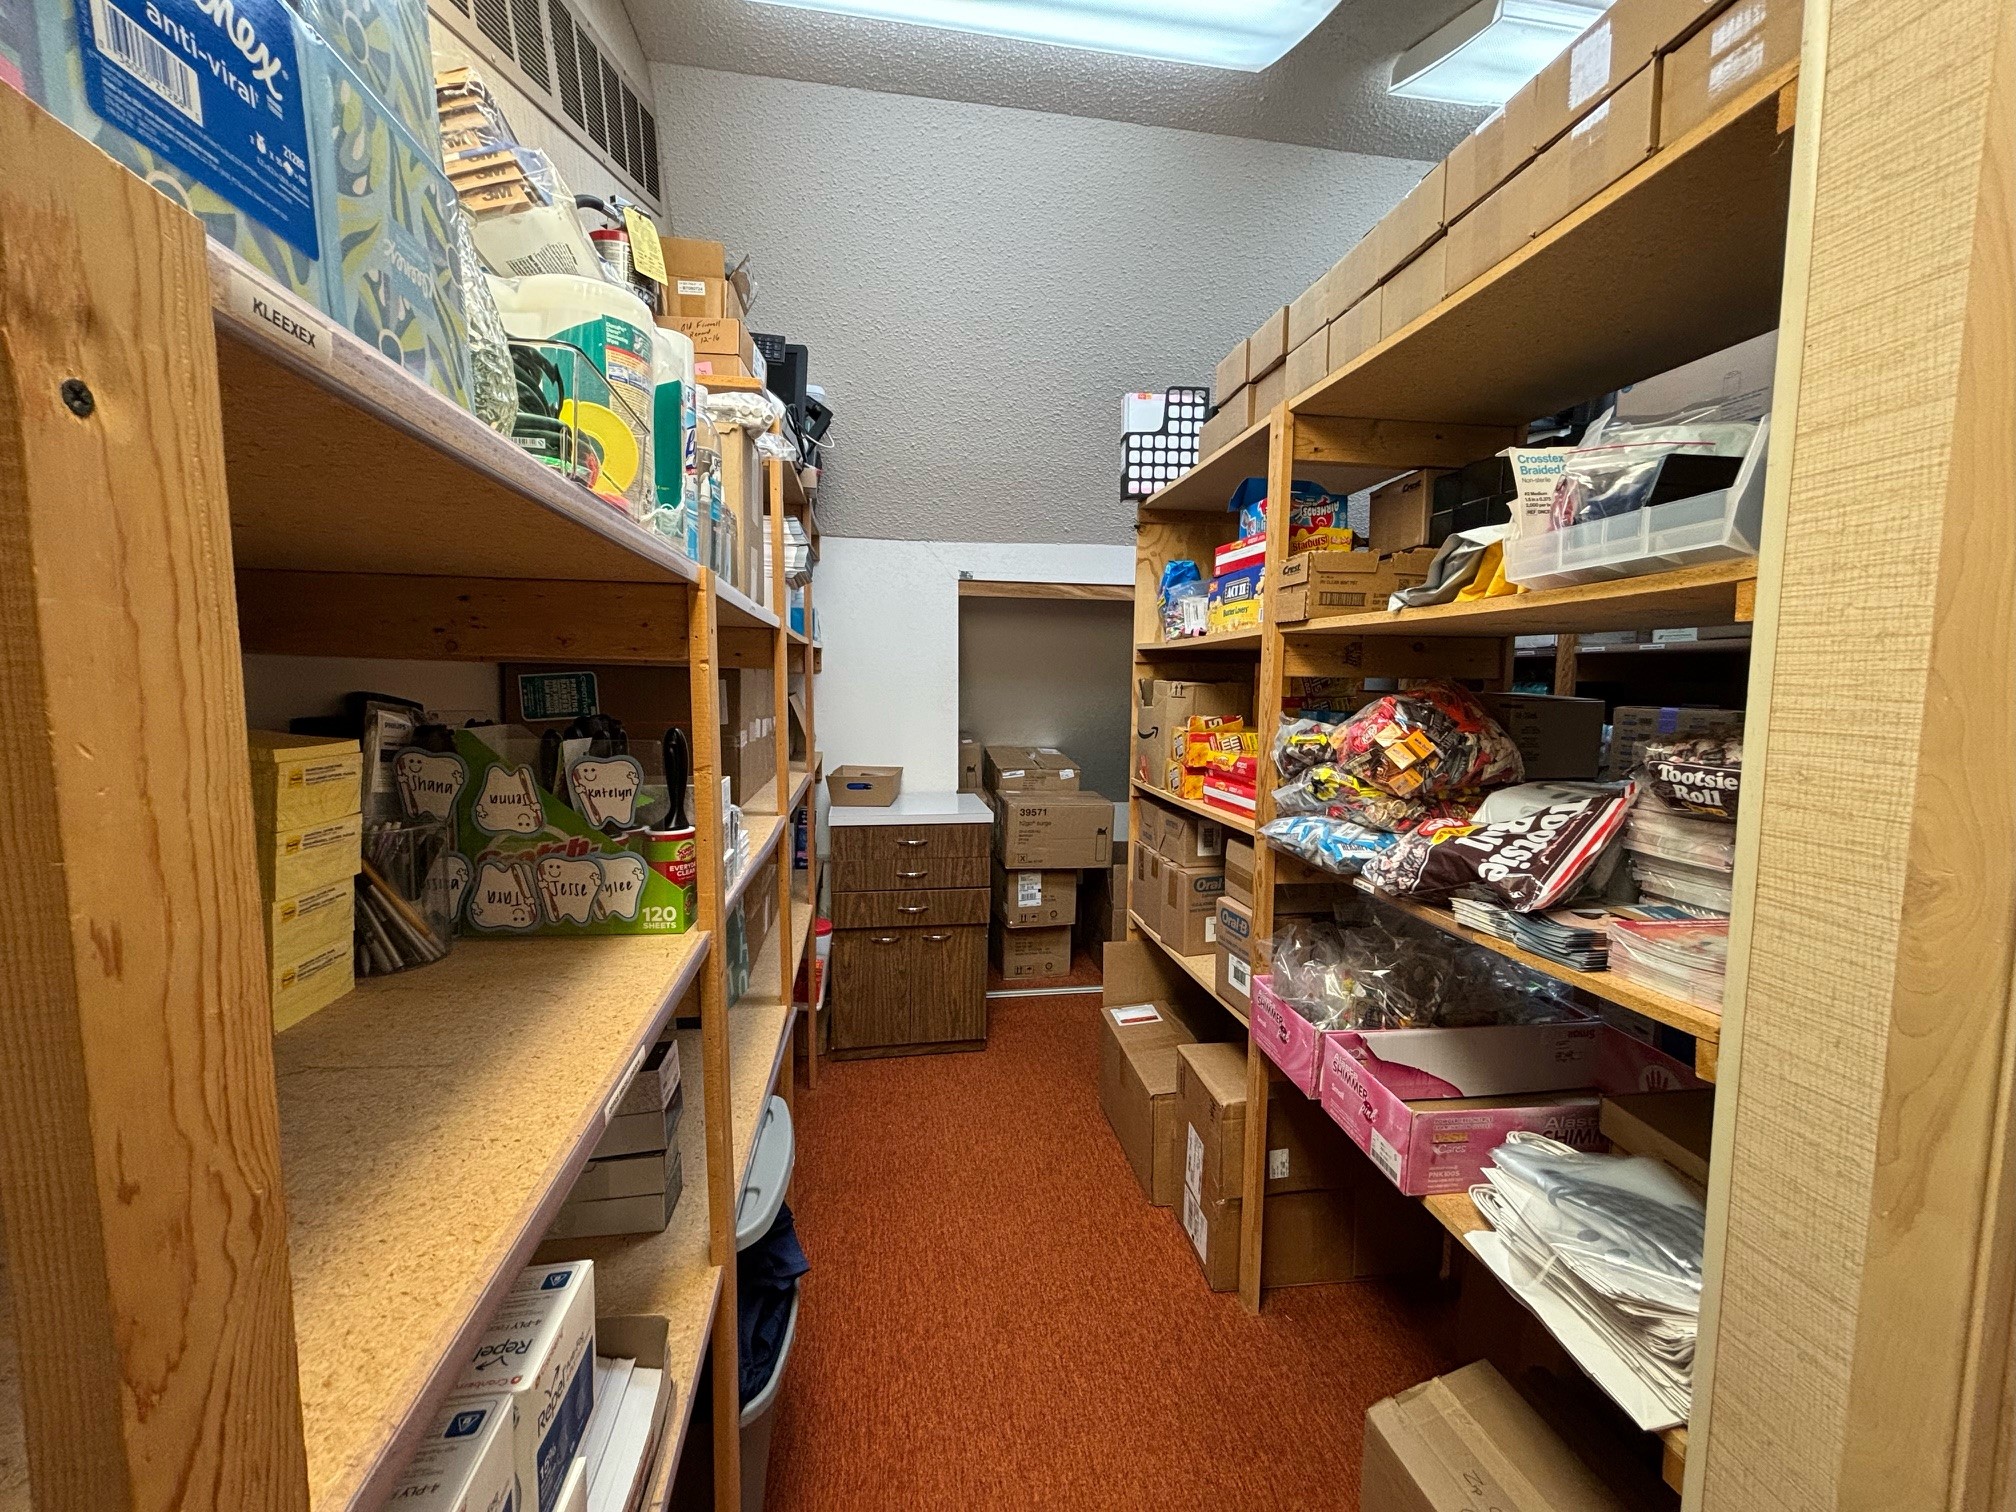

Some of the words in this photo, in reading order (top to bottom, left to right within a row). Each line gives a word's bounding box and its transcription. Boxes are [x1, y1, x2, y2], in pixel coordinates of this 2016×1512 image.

[146, 1, 257, 109] anti-viral
[482, 186, 513, 202] 3M
[252, 296, 317, 349] KLEEXEX
[1517, 454, 1565, 464] Crosstex
[1519, 465, 1561, 475] Braided
[1301, 500, 1340, 517] AIRHEADS
[1282, 562, 1302, 576] Crest
[411, 774, 454, 795] Shana
[1658, 763, 1739, 791] Tootsie
[588, 785, 633, 800] Katelyn
[1672, 784, 1723, 806] Roll
[1019, 808, 1048, 816] 39571
[1454, 816, 1537, 853] Roll
[1477, 798, 1593, 882] Tootsie
[549, 877, 588, 897] Jesse
[642, 906, 678, 922] 120
[1222, 910, 1248, 935] Oral-B
[642, 921, 678, 930] SHEETS
[1256, 996, 1284, 1025] SHIMMER
[1331, 1061, 1368, 1100] SHIMMER
[473, 1338, 533, 1361] Repel
[537, 1369, 565, 1438] Repel
